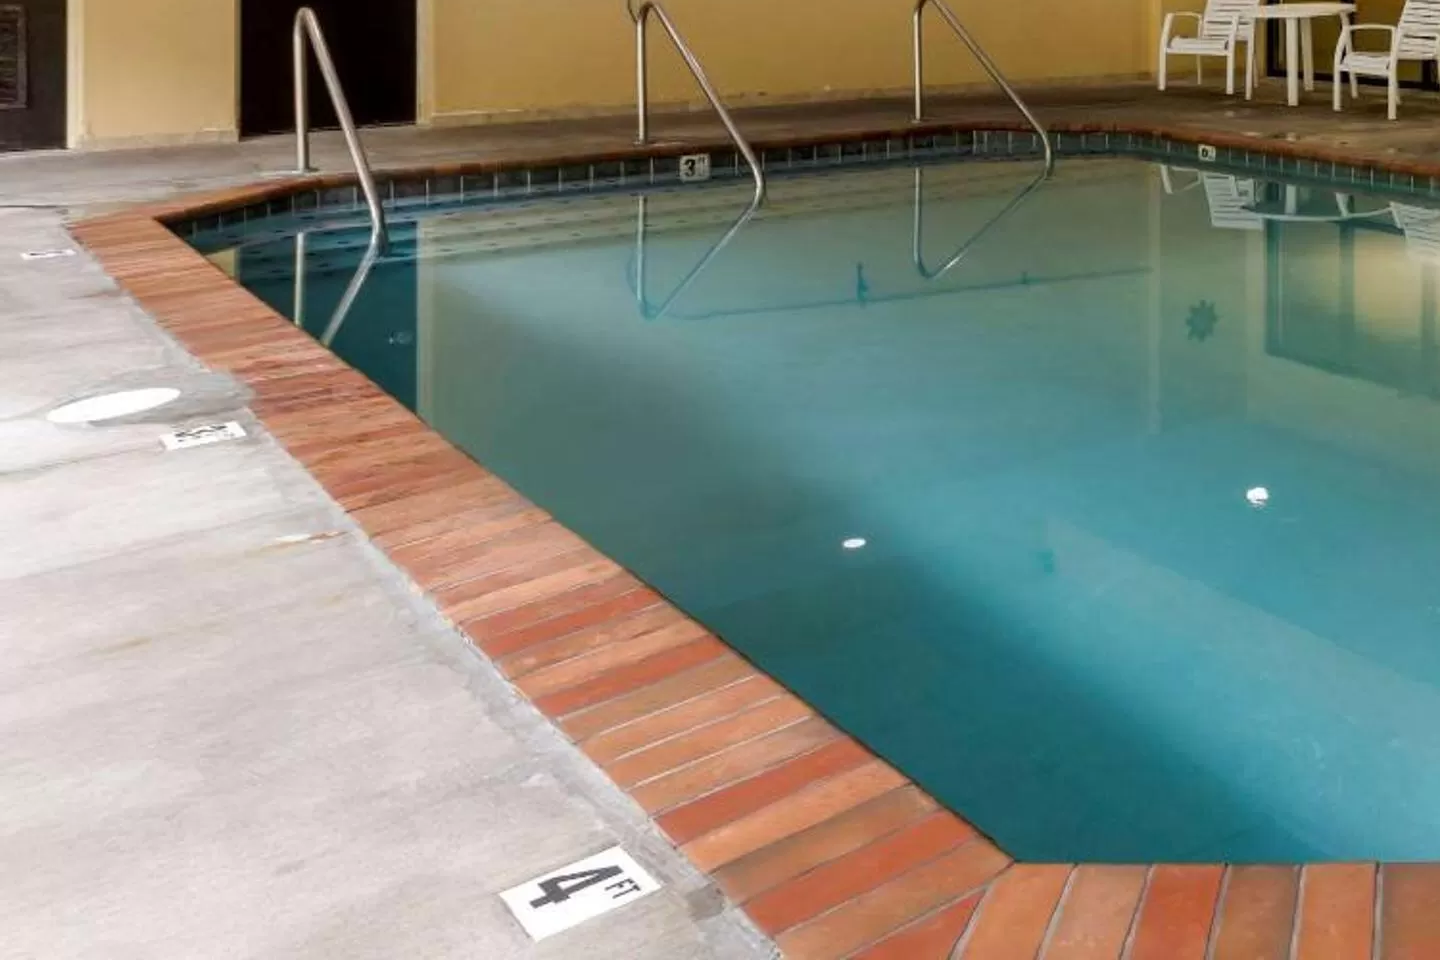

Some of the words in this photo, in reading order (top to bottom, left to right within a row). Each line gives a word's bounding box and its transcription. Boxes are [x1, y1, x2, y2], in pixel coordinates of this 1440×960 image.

[683, 159, 696, 177] 3
[529, 865, 623, 909] 4
[604, 878, 641, 899] FT
